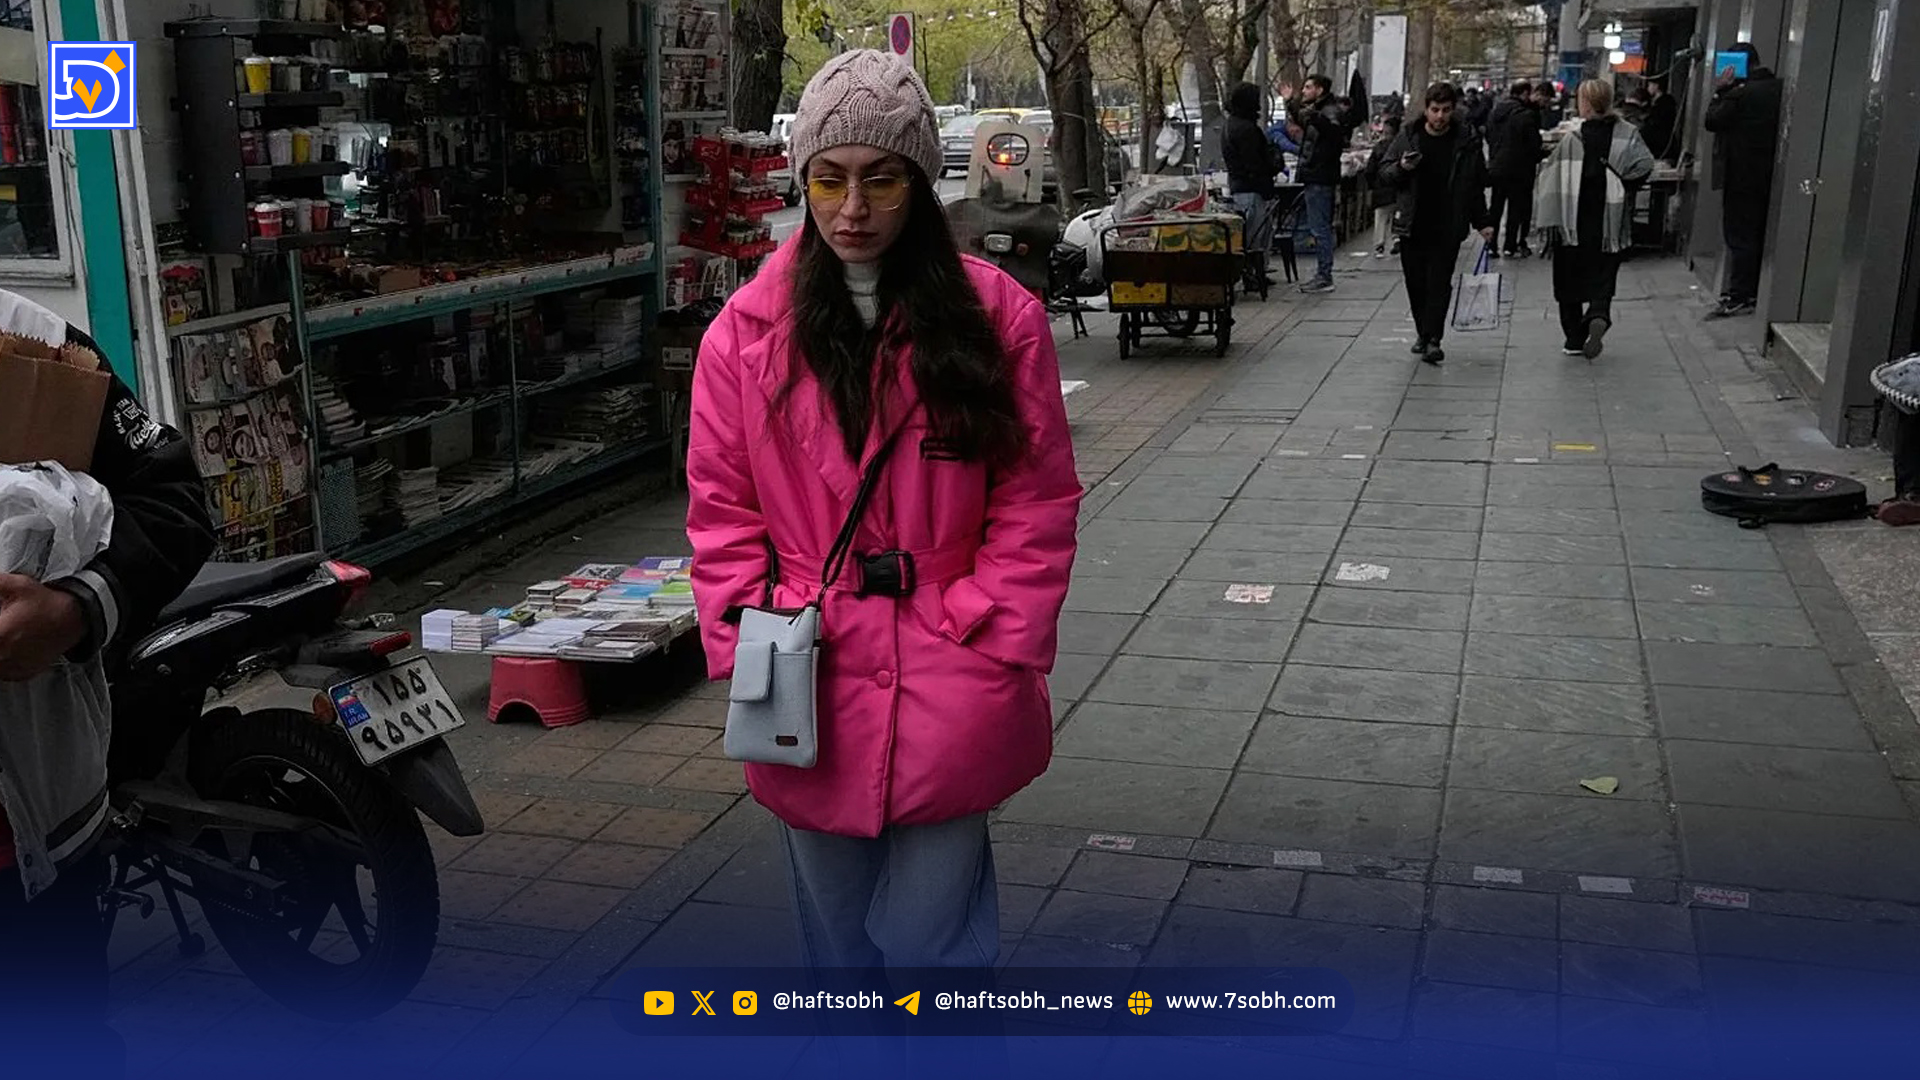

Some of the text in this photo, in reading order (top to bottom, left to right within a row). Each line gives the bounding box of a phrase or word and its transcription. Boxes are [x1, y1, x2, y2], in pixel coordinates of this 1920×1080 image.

[372, 668, 427, 706] ۱۵۵
[347, 712, 370, 727] IRAN
[362, 699, 456, 751] ۹۵۹۳۱
